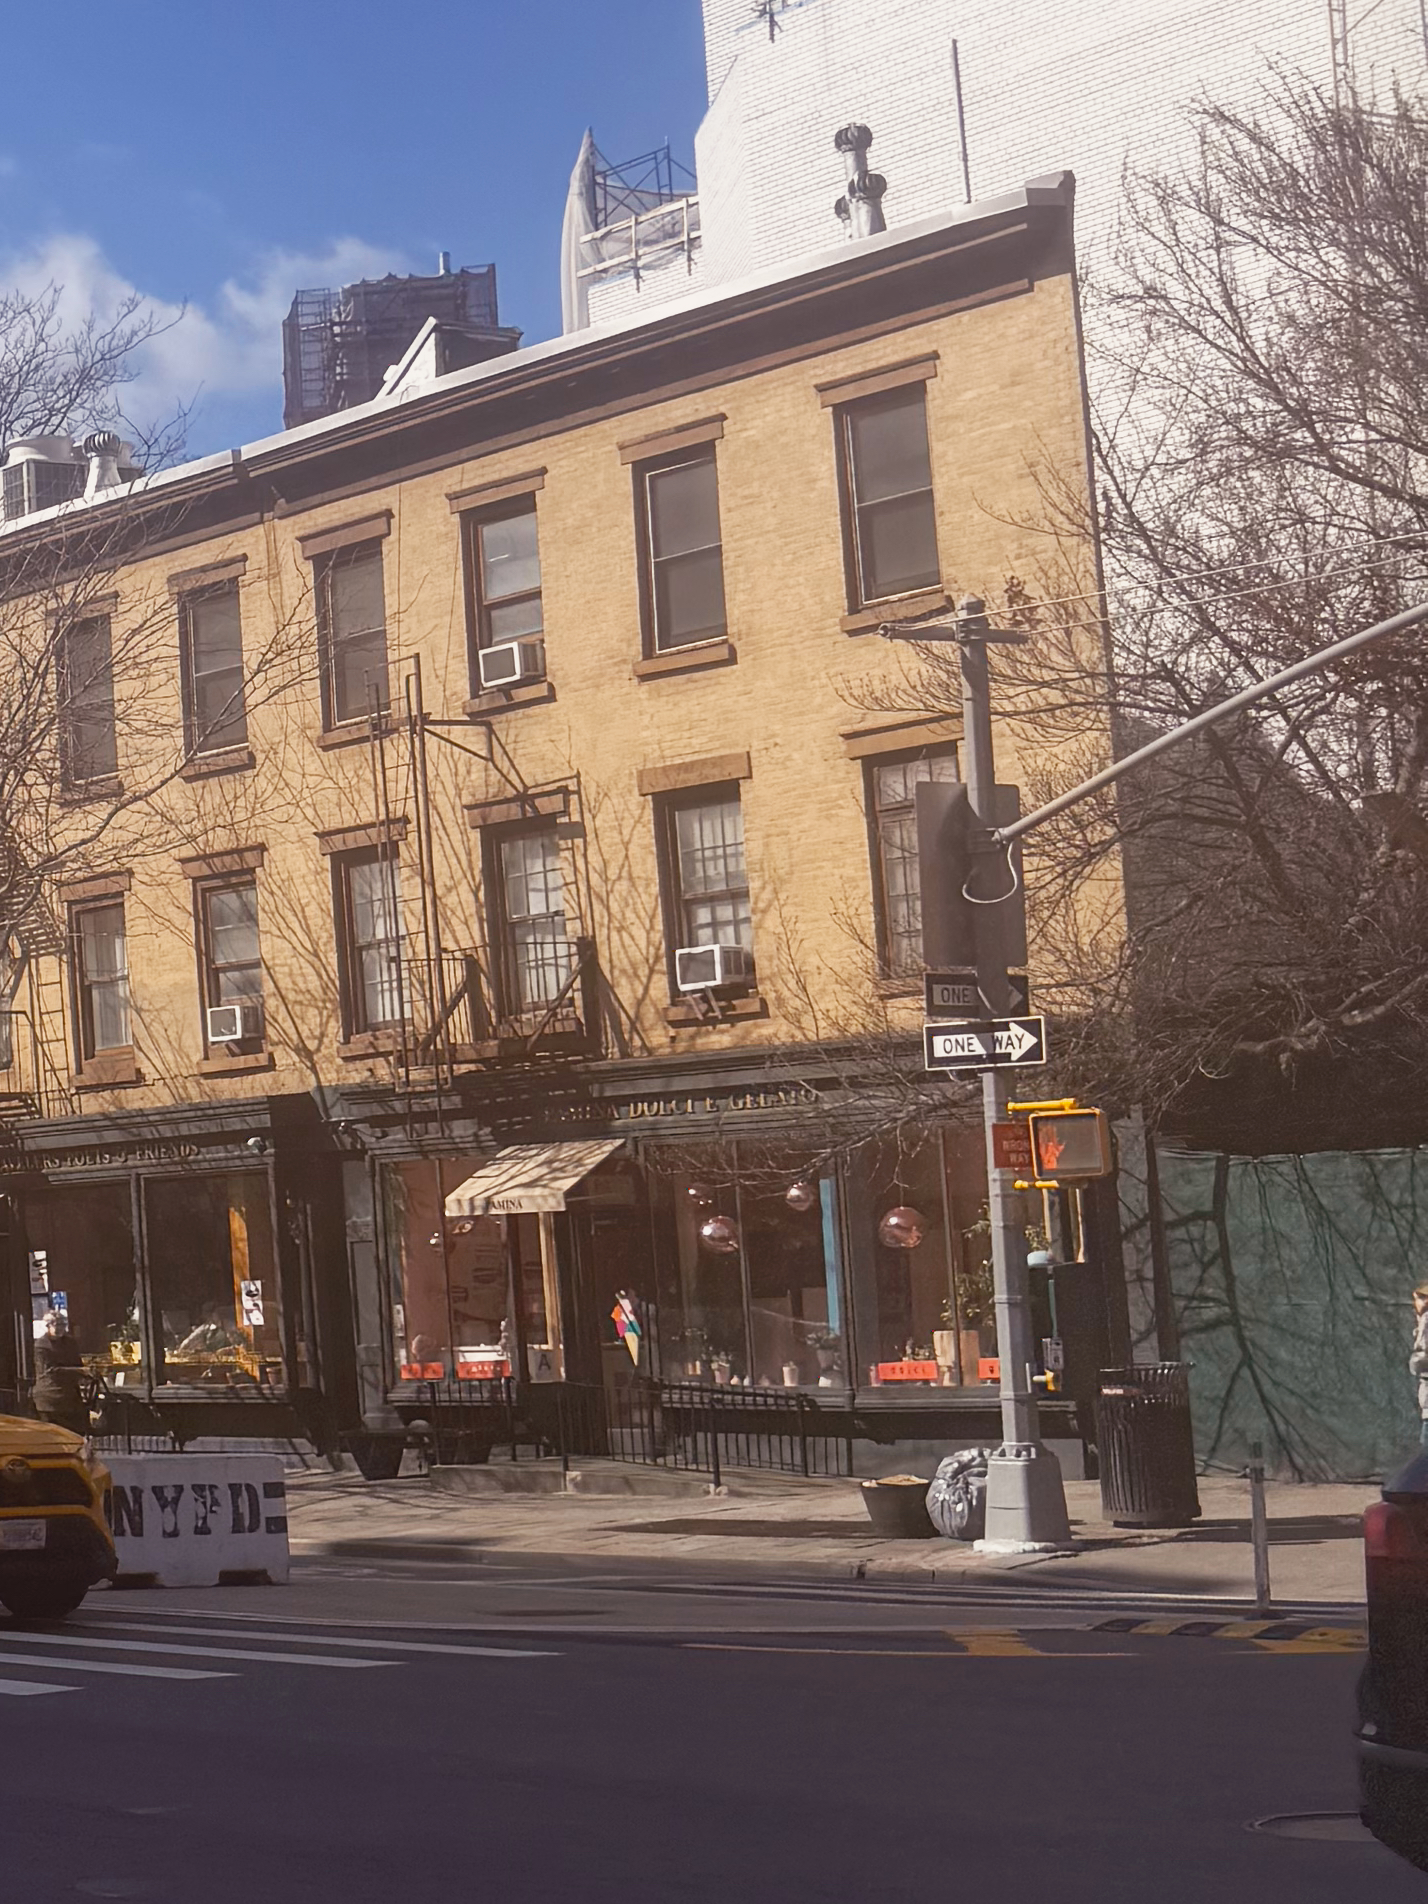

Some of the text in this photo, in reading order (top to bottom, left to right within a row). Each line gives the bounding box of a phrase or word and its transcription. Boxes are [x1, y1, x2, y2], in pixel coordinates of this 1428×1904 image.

[940, 986, 972, 1005] ONE
[943, 1033, 1025, 1054] ONE WAY
[630, 1099, 695, 1118] DOLCI
[705, 1097, 720, 1112] E
[729, 1088, 819, 1110] GELATO
[136, 1141, 199, 1160] FRIENDS
[484, 1199, 524, 1211] AMINA
[538, 1354, 551, 1371] A
[112, 1482, 262, 1538] NYPD
